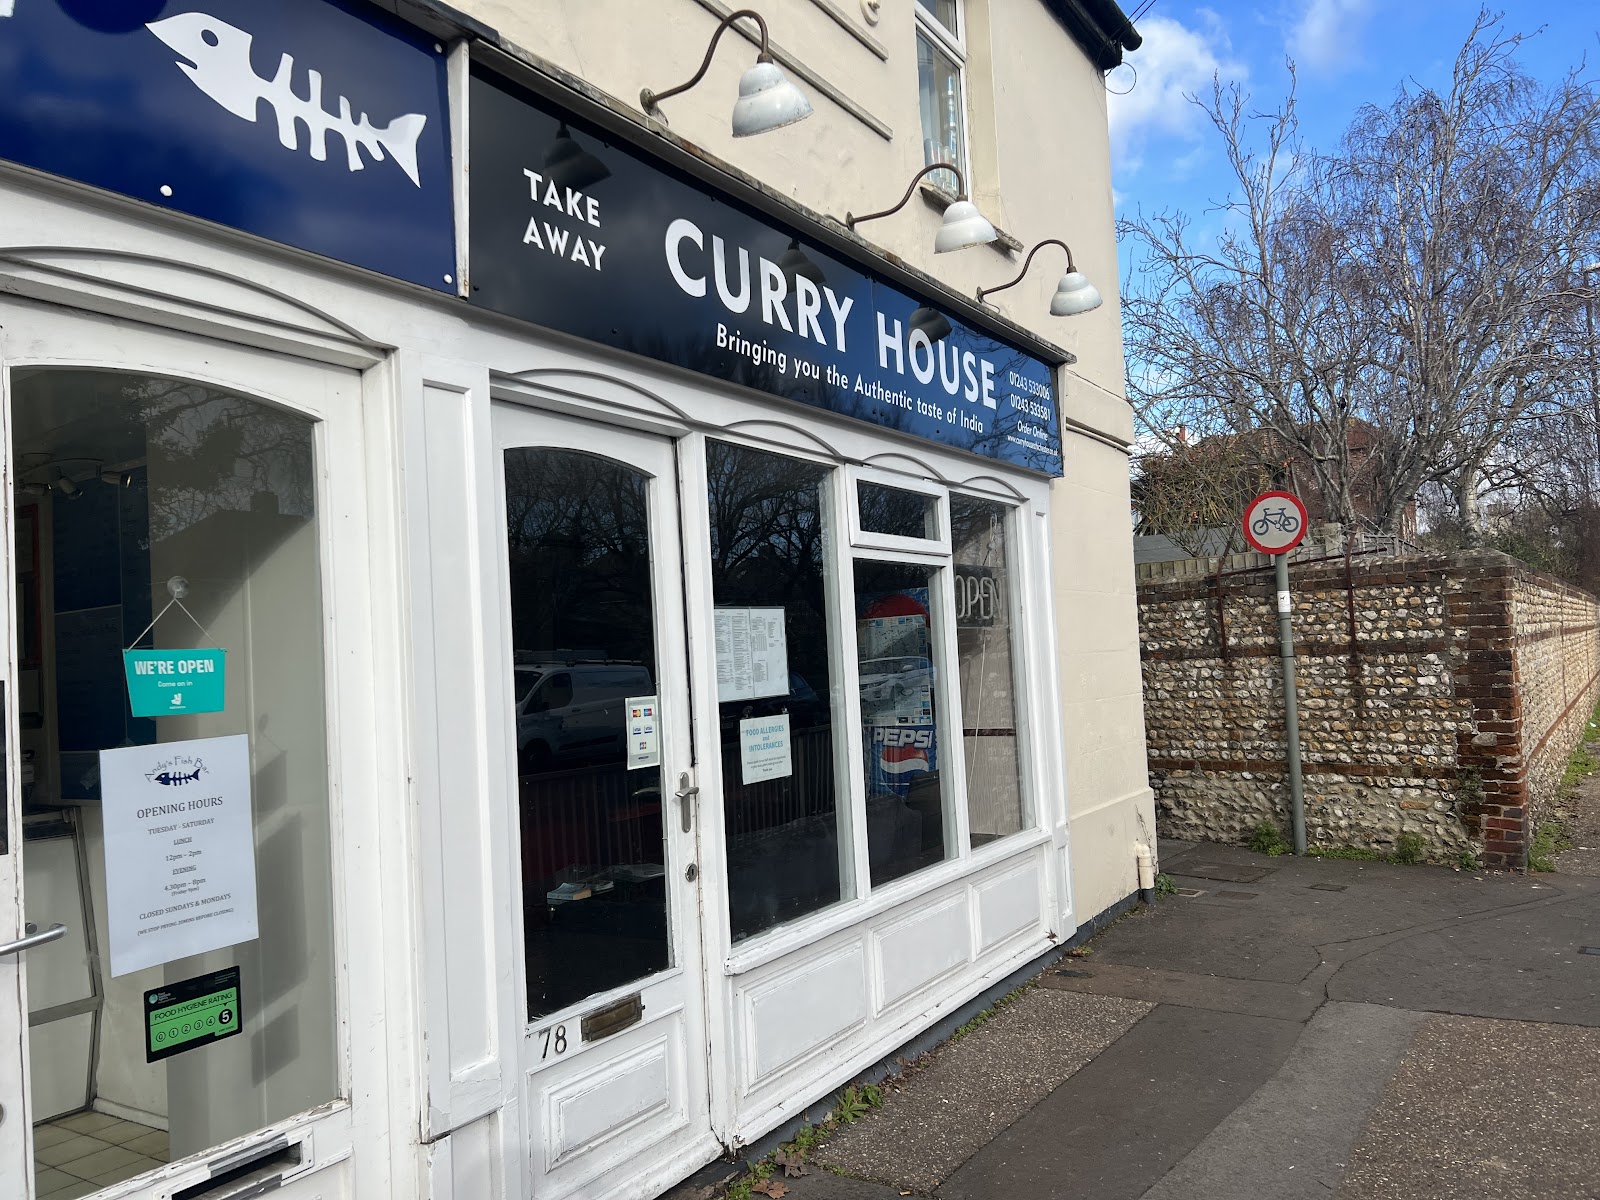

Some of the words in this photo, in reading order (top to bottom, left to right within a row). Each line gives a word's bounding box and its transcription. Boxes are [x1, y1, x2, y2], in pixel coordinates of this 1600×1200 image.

[523, 167, 601, 228] TAKE
[522, 216, 607, 271] AWAY
[664, 217, 855, 353] CURRY
[876, 311, 997, 410] HOUSE
[716, 322, 787, 374] Bringing
[794, 357, 820, 379] you
[826, 364, 849, 389] the
[854, 373, 913, 411] Authentic
[917, 397, 943, 421] taste
[947, 407, 957, 425] of
[960, 410, 983, 434] India
[1009, 371, 1028, 391] 01243
[1028, 378, 1050, 400] 533006
[1010, 393, 1029, 413] 01243
[1030, 401, 1051, 421] 533581
[1017, 420, 1032, 435] Order
[1032, 425, 1049, 441] Online
[955, 575, 1002, 619] OPEN
[134, 660, 175, 675] WE'RE
[177, 659, 214, 674] OPEN
[157, 680, 177, 688] Come
[746, 729, 760, 737] FOOD
[760, 724, 785, 735] ALLERGIES
[872, 726, 934, 749] PEPSI
[748, 740, 784, 752] INTOLERANCES
[145, 760, 173, 783] Andy's
[174, 755, 193, 766] Fish
[194, 757, 210, 775] Bar
[136, 802, 186, 819] OPENING
[188, 796, 223, 811] HOURS
[148, 824, 178, 835] TUESDAY
[182, 818, 215, 829] SATURDAY
[173, 837, 192, 846] LUNCH
[165, 854, 183, 862] 12pm
[188, 850, 202, 858] 2pm
[172, 865, 197, 875] EVENING
[164, 882, 187, 891] 4.30pm
[139, 908, 164, 920] CLOSED
[165, 901, 194, 914] SUNDAYS
[201, 892, 231, 905] MONDAYS
[154, 1009, 177, 1021] FOOD
[177, 1000, 208, 1014] HYGIENE
[208, 991, 233, 1005] RATING
[538, 1025, 568, 1062] 78
